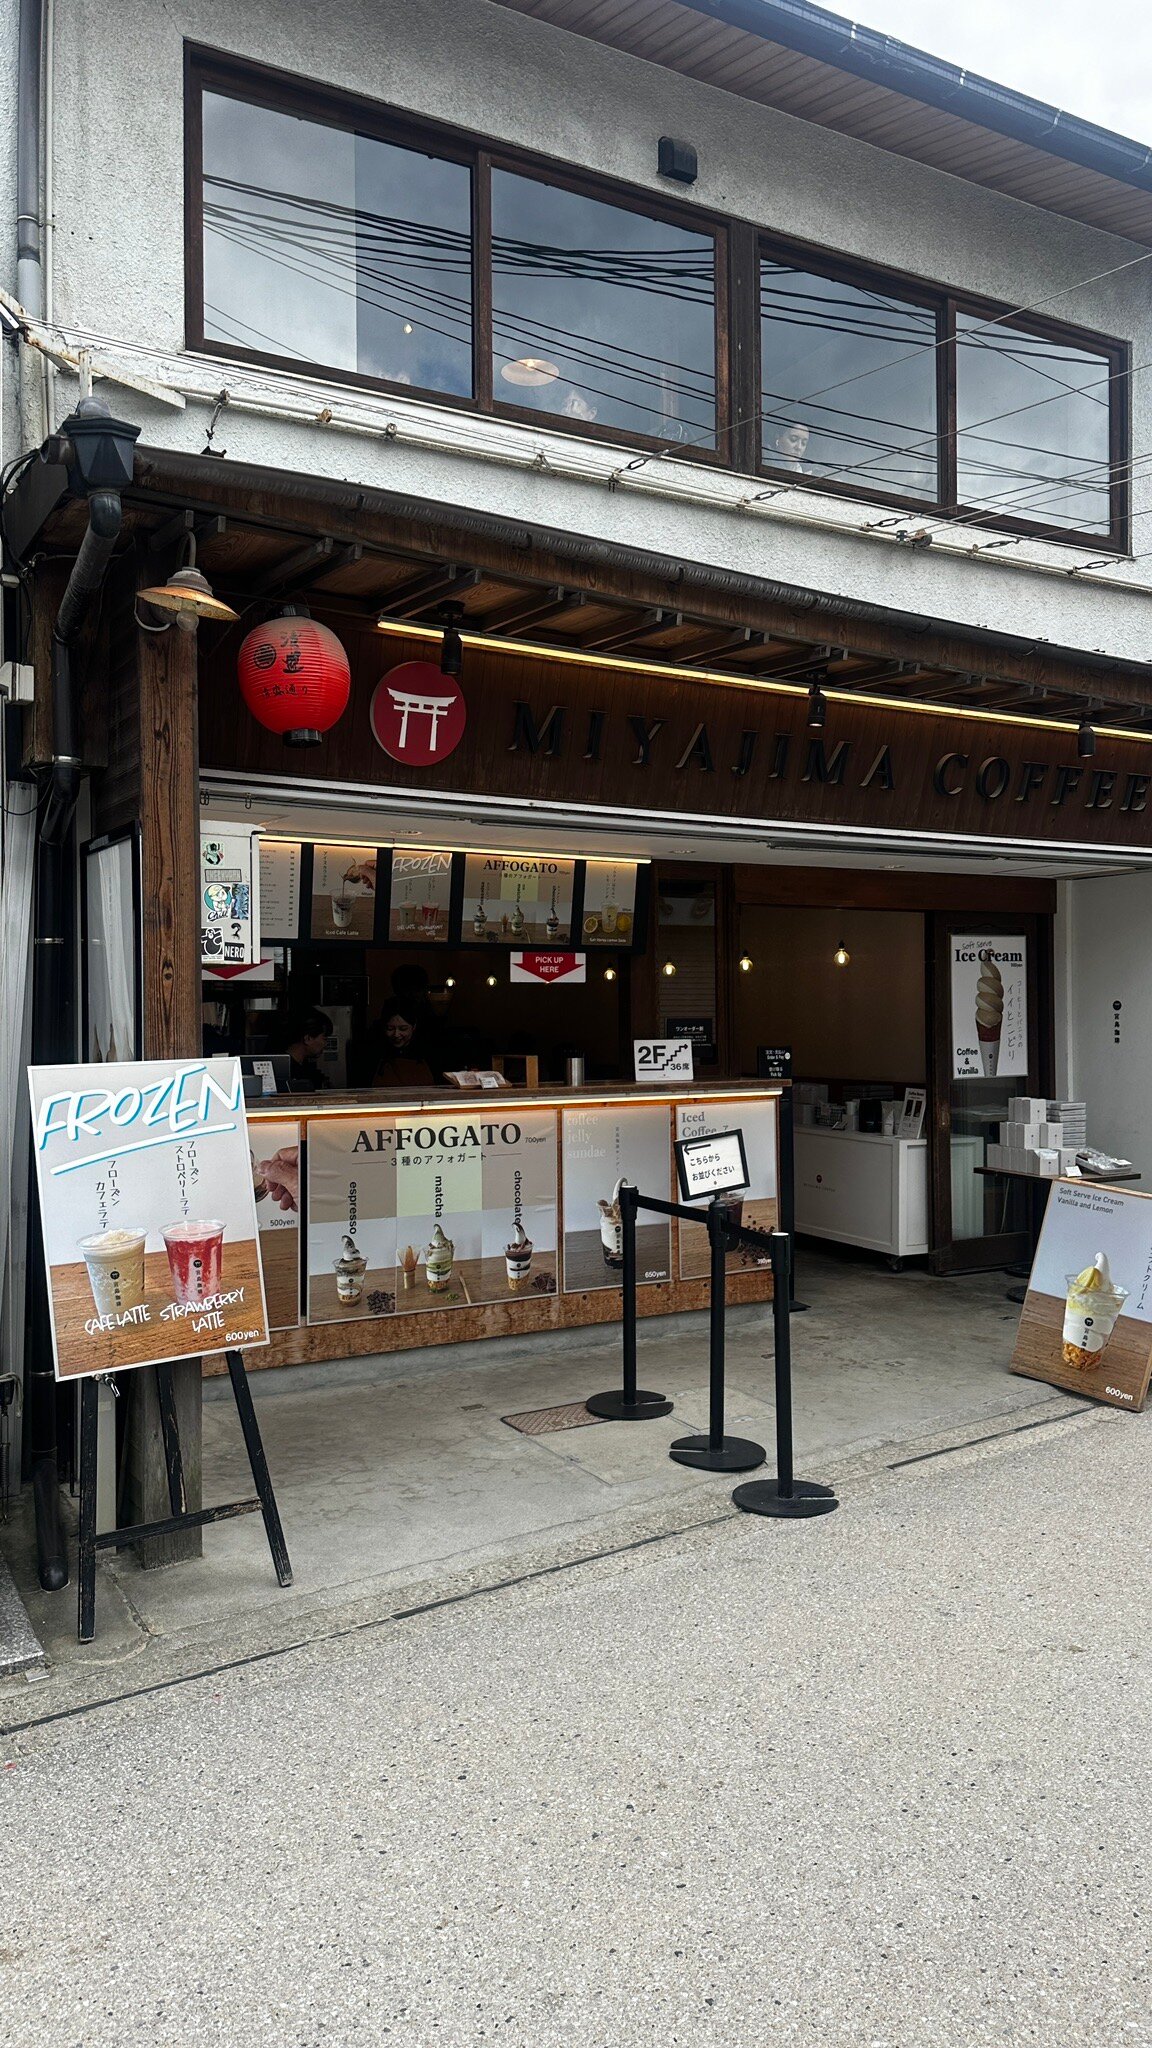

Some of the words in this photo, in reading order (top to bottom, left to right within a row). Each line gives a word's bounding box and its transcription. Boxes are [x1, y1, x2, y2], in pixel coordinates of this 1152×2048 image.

[507, 700, 895, 790] MIYAJIMA
[934, 752, 1151, 812] COFFEE
[392, 853, 452, 873] FROZEN
[483, 859, 558, 874] AFFOGATO
[535, 956, 553, 964] PICK
[955, 949, 976, 962] Ice
[978, 949, 1023, 962] Cream
[638, 1045, 666, 1064] 2F
[957, 1048, 978, 1056] Coffee
[670, 1063, 690, 1071] 36席
[957, 1067, 978, 1075] Vanilla
[38, 1064, 241, 1150] FROZEN
[567, 1113, 598, 1126] coffee
[682, 1112, 705, 1122] Iced
[352, 1123, 521, 1153] AFFOGATO
[567, 1129, 592, 1144] jelly
[567, 1145, 606, 1159] sundae
[690, 1153, 721, 1166] こちらから
[187, 1141, 199, 1185] フローズン
[692, 1165, 735, 1181] お並びください
[107, 1161, 120, 1206] フローズン
[434, 1175, 444, 1218] matcha
[514, 1170, 523, 1224] chocolate
[1059, 1187, 1072, 1195] Soft
[1073, 1190, 1091, 1199] Serve
[1092, 1194, 1102, 1202] Ice
[1103, 1196, 1124, 1206] Cream
[96, 1182, 110, 1228] カフェラテ
[349, 1181, 357, 1235] espresso
[1057, 1197, 1078, 1206] Vanilla
[1092, 1204, 1113, 1214] Lemon
[270, 1218, 295, 1228] 500yen
[644, 1270, 667, 1279] 650yen
[160, 1287, 244, 1321] STRAWBERRY
[85, 1314, 115, 1335] CAFE
[117, 1304, 151, 1327] LATTE
[191, 1311, 225, 1334] LATTE
[225, 1329, 259, 1342] 600yen
[1105, 1386, 1133, 1401] 600yen
